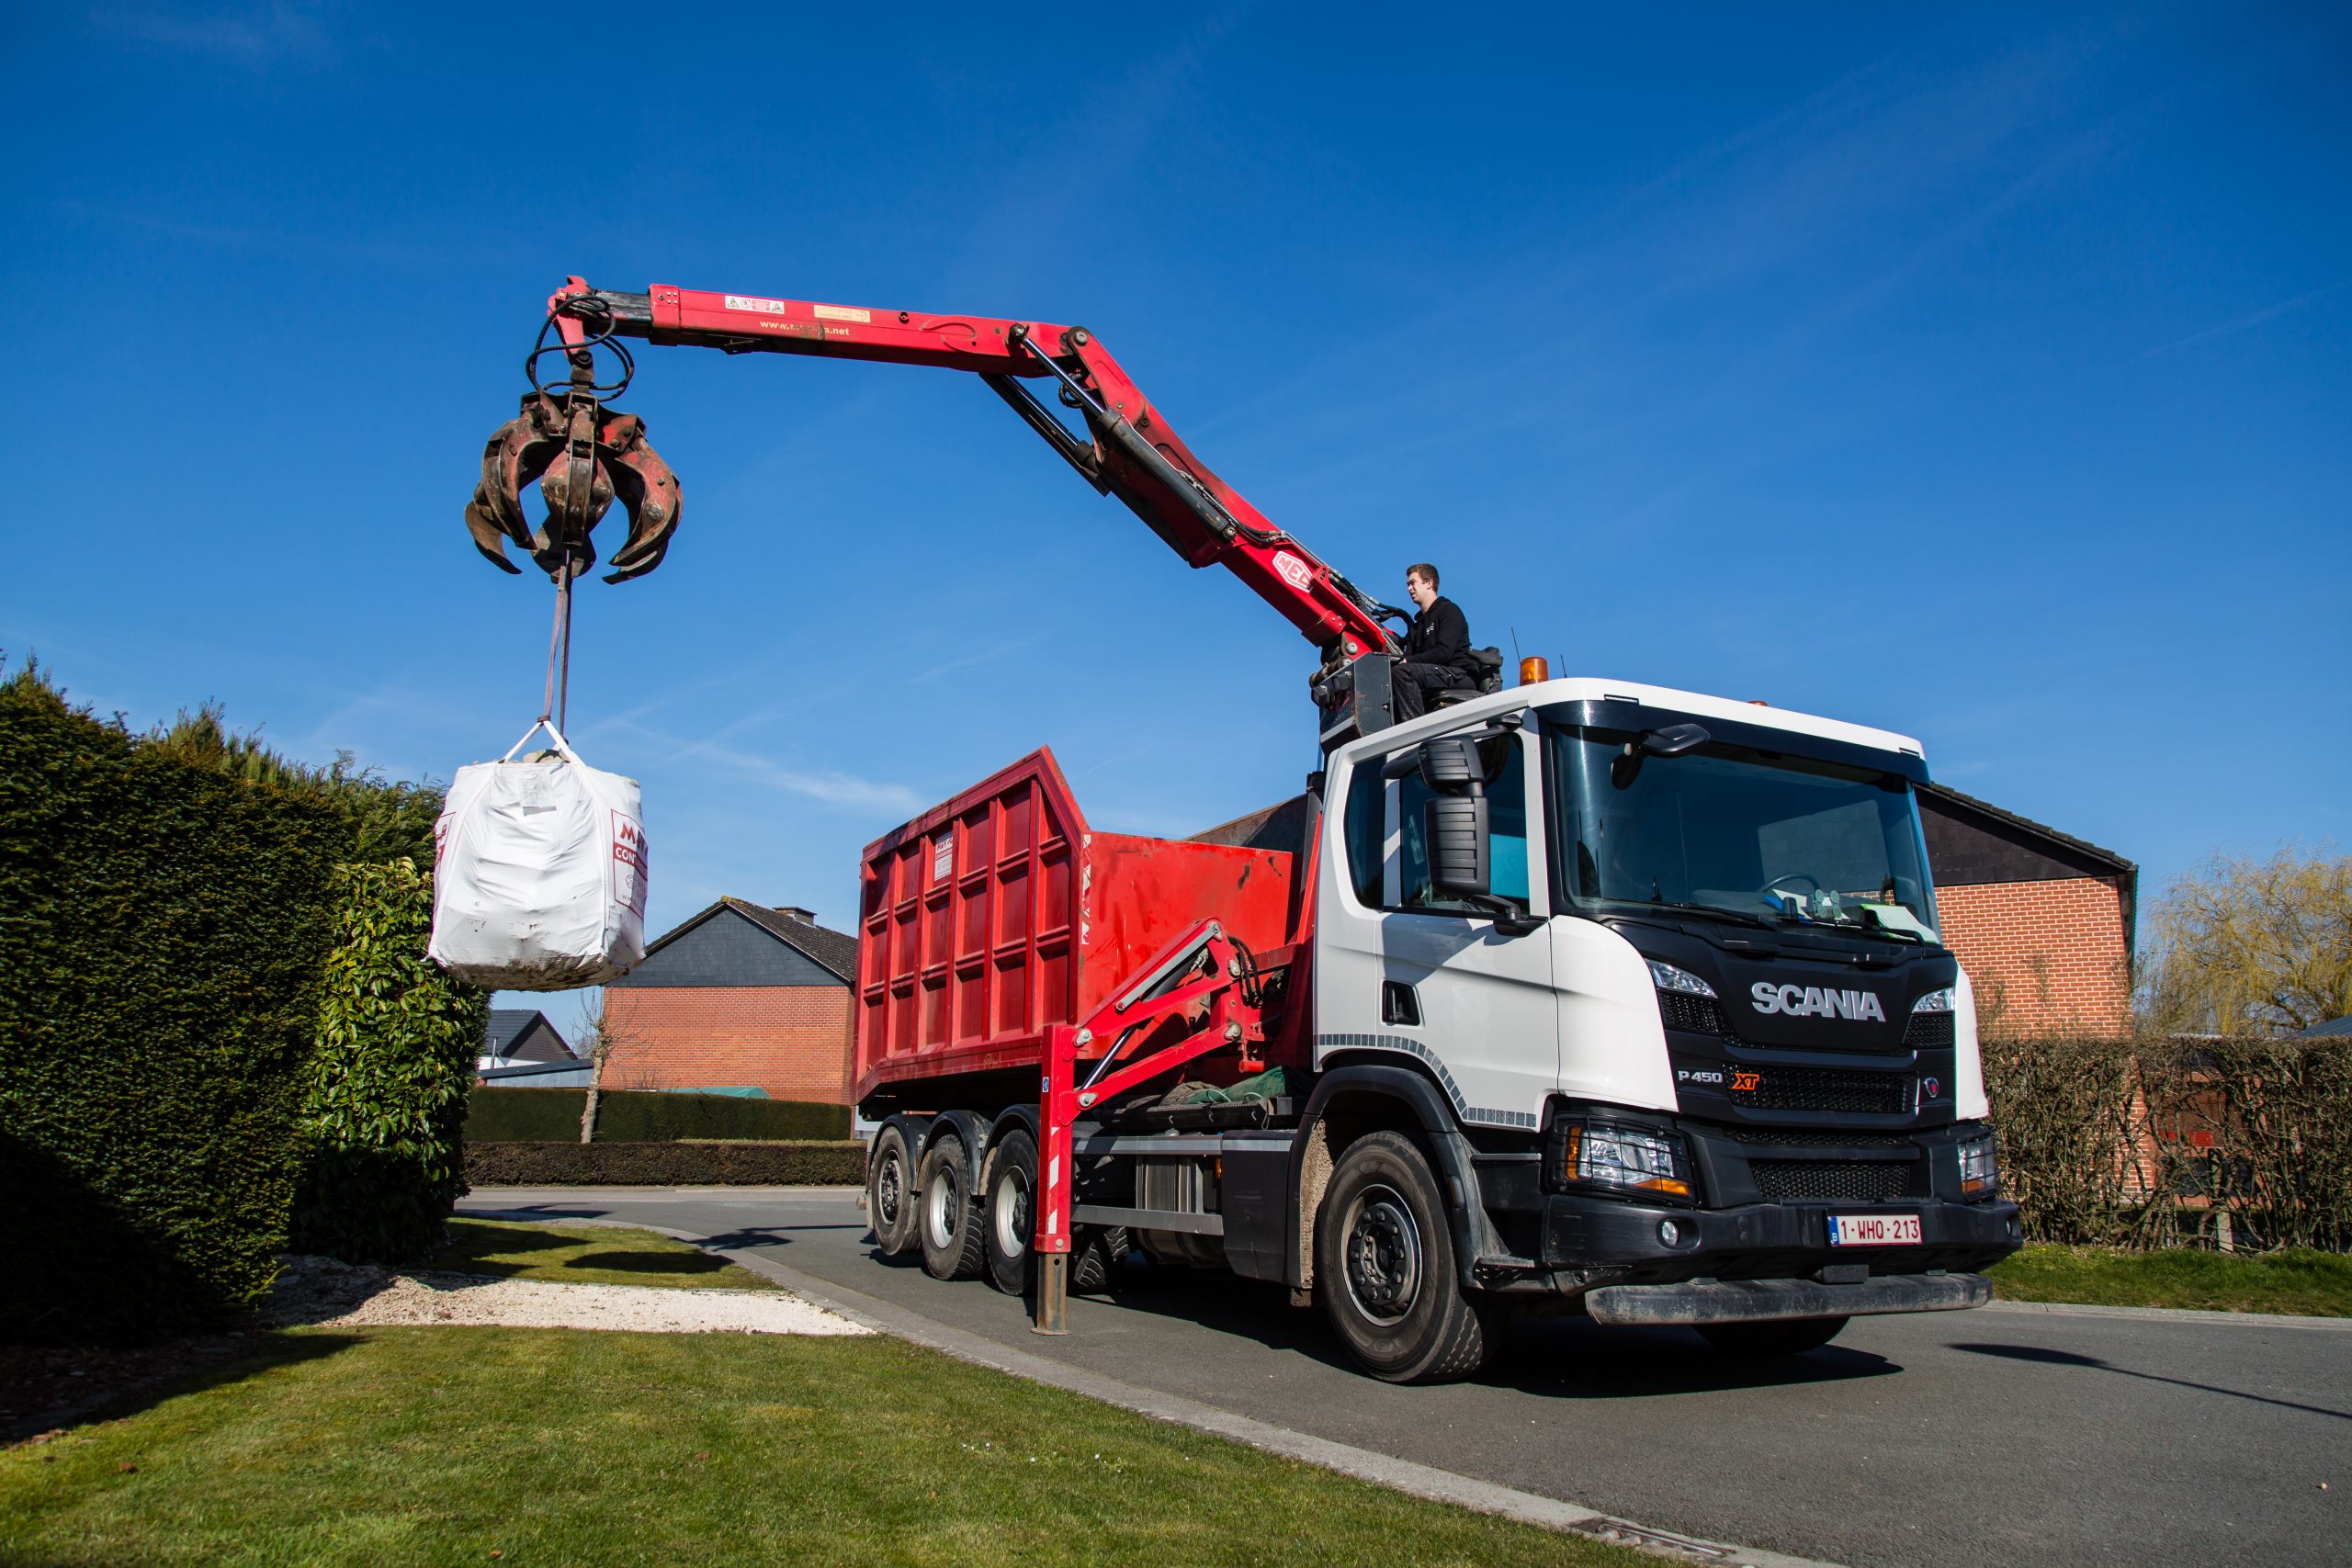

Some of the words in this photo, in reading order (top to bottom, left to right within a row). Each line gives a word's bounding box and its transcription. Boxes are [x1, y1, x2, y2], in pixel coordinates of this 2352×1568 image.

[1751, 982, 1886, 1022] SCANIA
[1678, 1070, 1690, 1081] P
[1691, 1071, 1723, 1083] 450
[1732, 1073, 1760, 1090] XT
[1831, 1232, 1838, 1242] B
